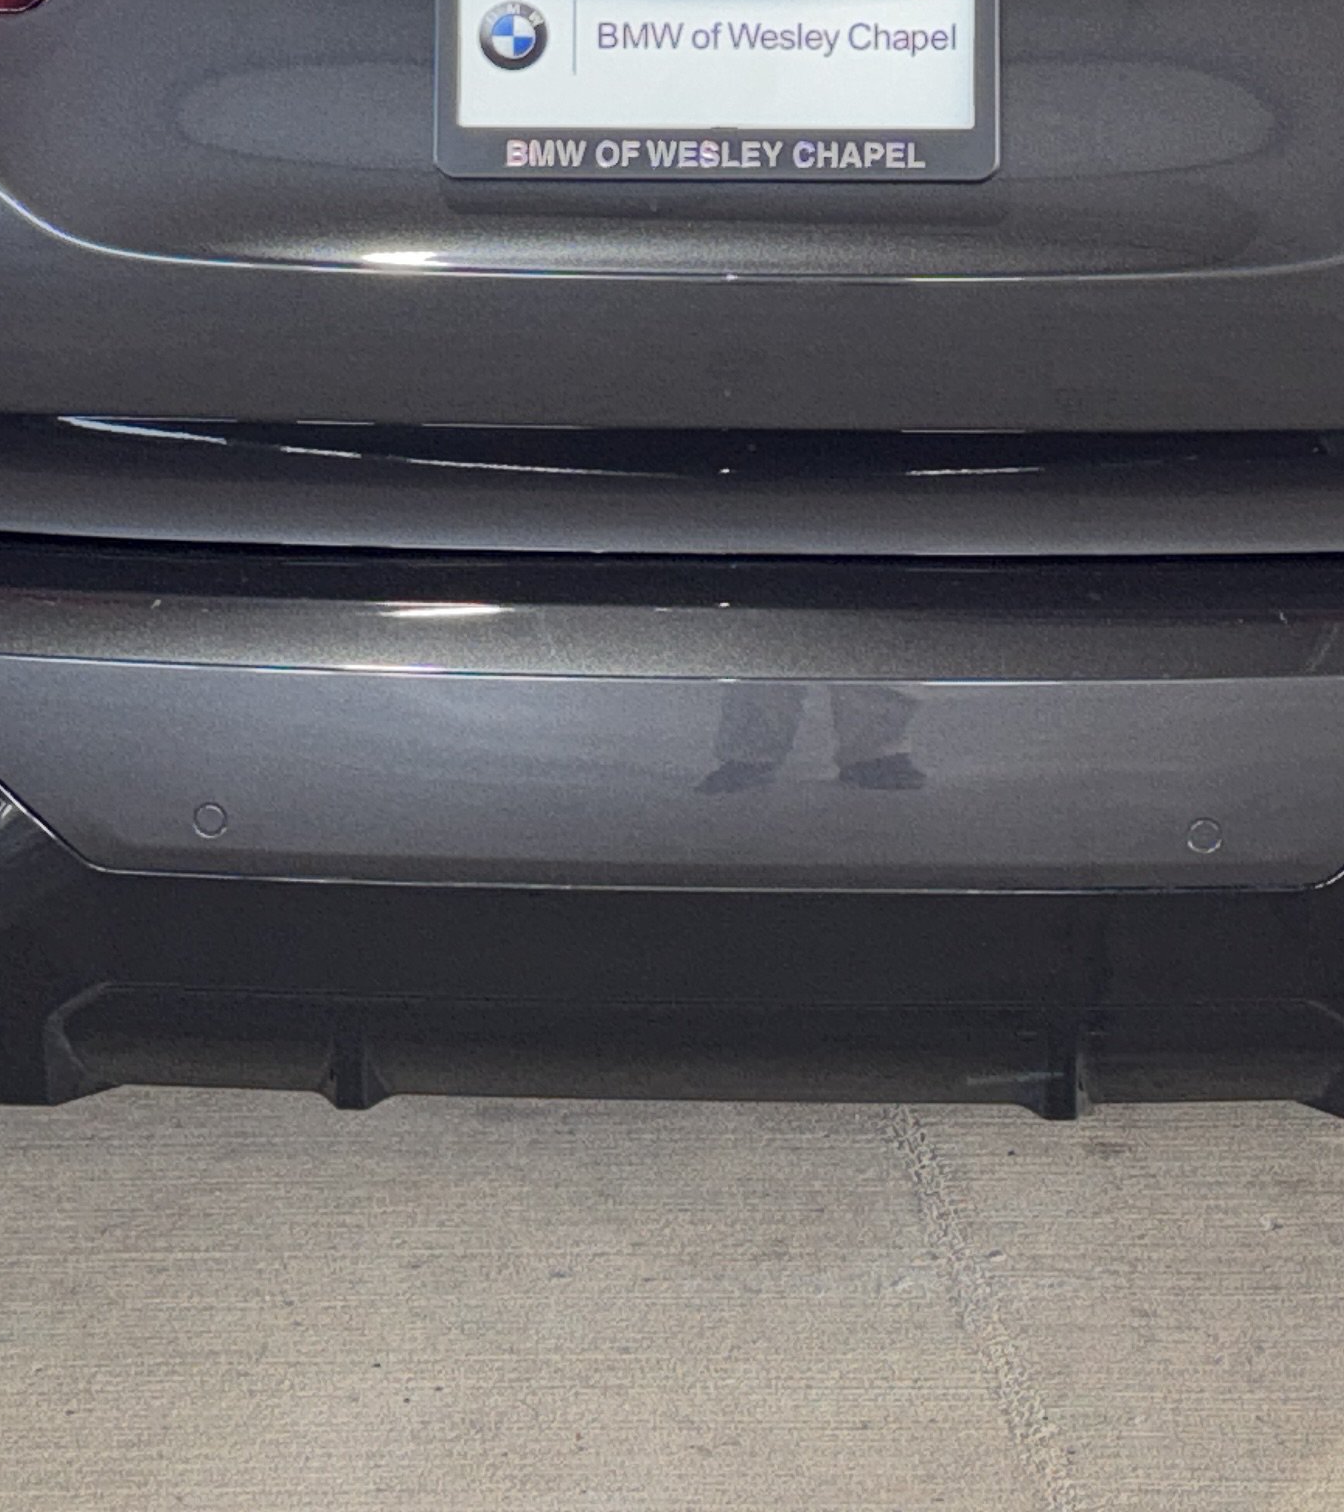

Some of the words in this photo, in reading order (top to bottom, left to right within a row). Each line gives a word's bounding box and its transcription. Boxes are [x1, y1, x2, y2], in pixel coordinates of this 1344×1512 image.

[597, 22, 685, 51] BMW
[691, 21, 723, 51] of
[728, 21, 840, 58] Wesley
[847, 21, 958, 58] Chapel
[506, 139, 587, 167] BMW
[595, 139, 641, 167] OF
[646, 139, 784, 169] WESLEY
[792, 141, 927, 169] CHAPEL
